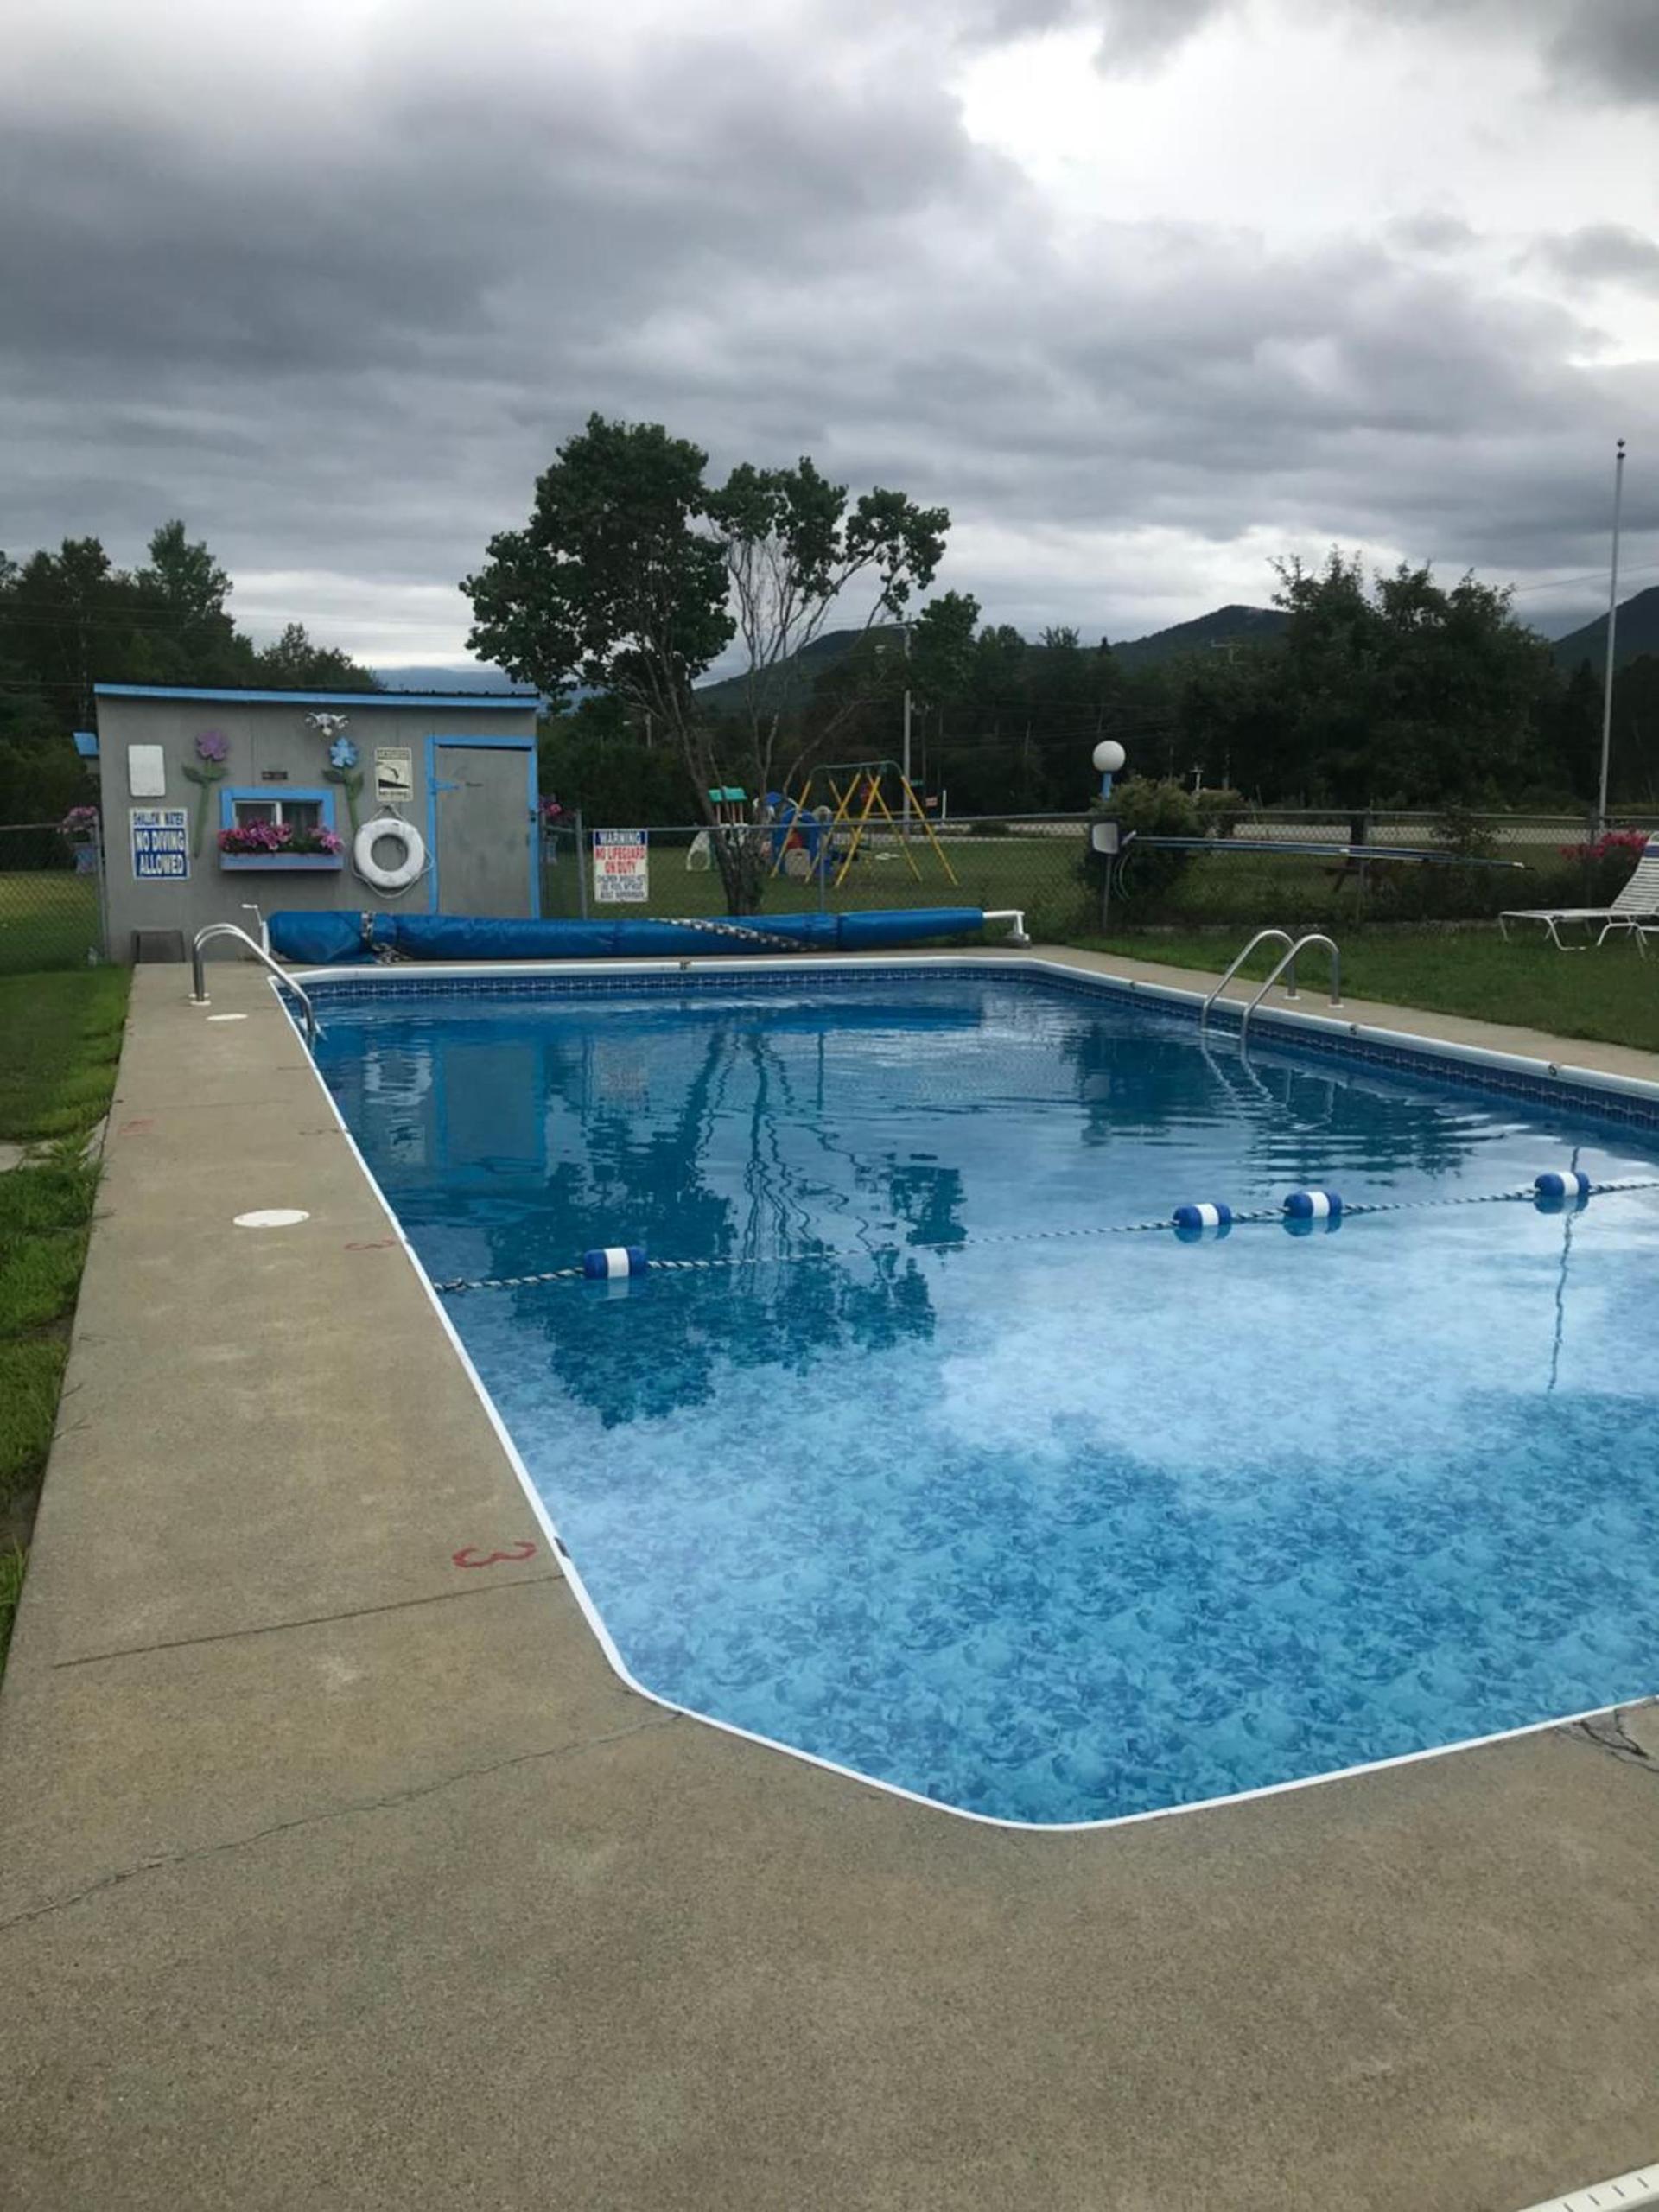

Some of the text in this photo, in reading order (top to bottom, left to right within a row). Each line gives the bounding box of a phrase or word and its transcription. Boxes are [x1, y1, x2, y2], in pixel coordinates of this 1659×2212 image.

[133, 811, 184, 825] SHALLOW WATER
[136, 830, 184, 852] NO DIVING
[598, 831, 642, 845] WARNING
[595, 847, 645, 860] NO LIFEGUARD
[139, 853, 184, 874] ALLOWED
[605, 861, 636, 874] ON DUTY
[452, 1540, 537, 1568] 3
